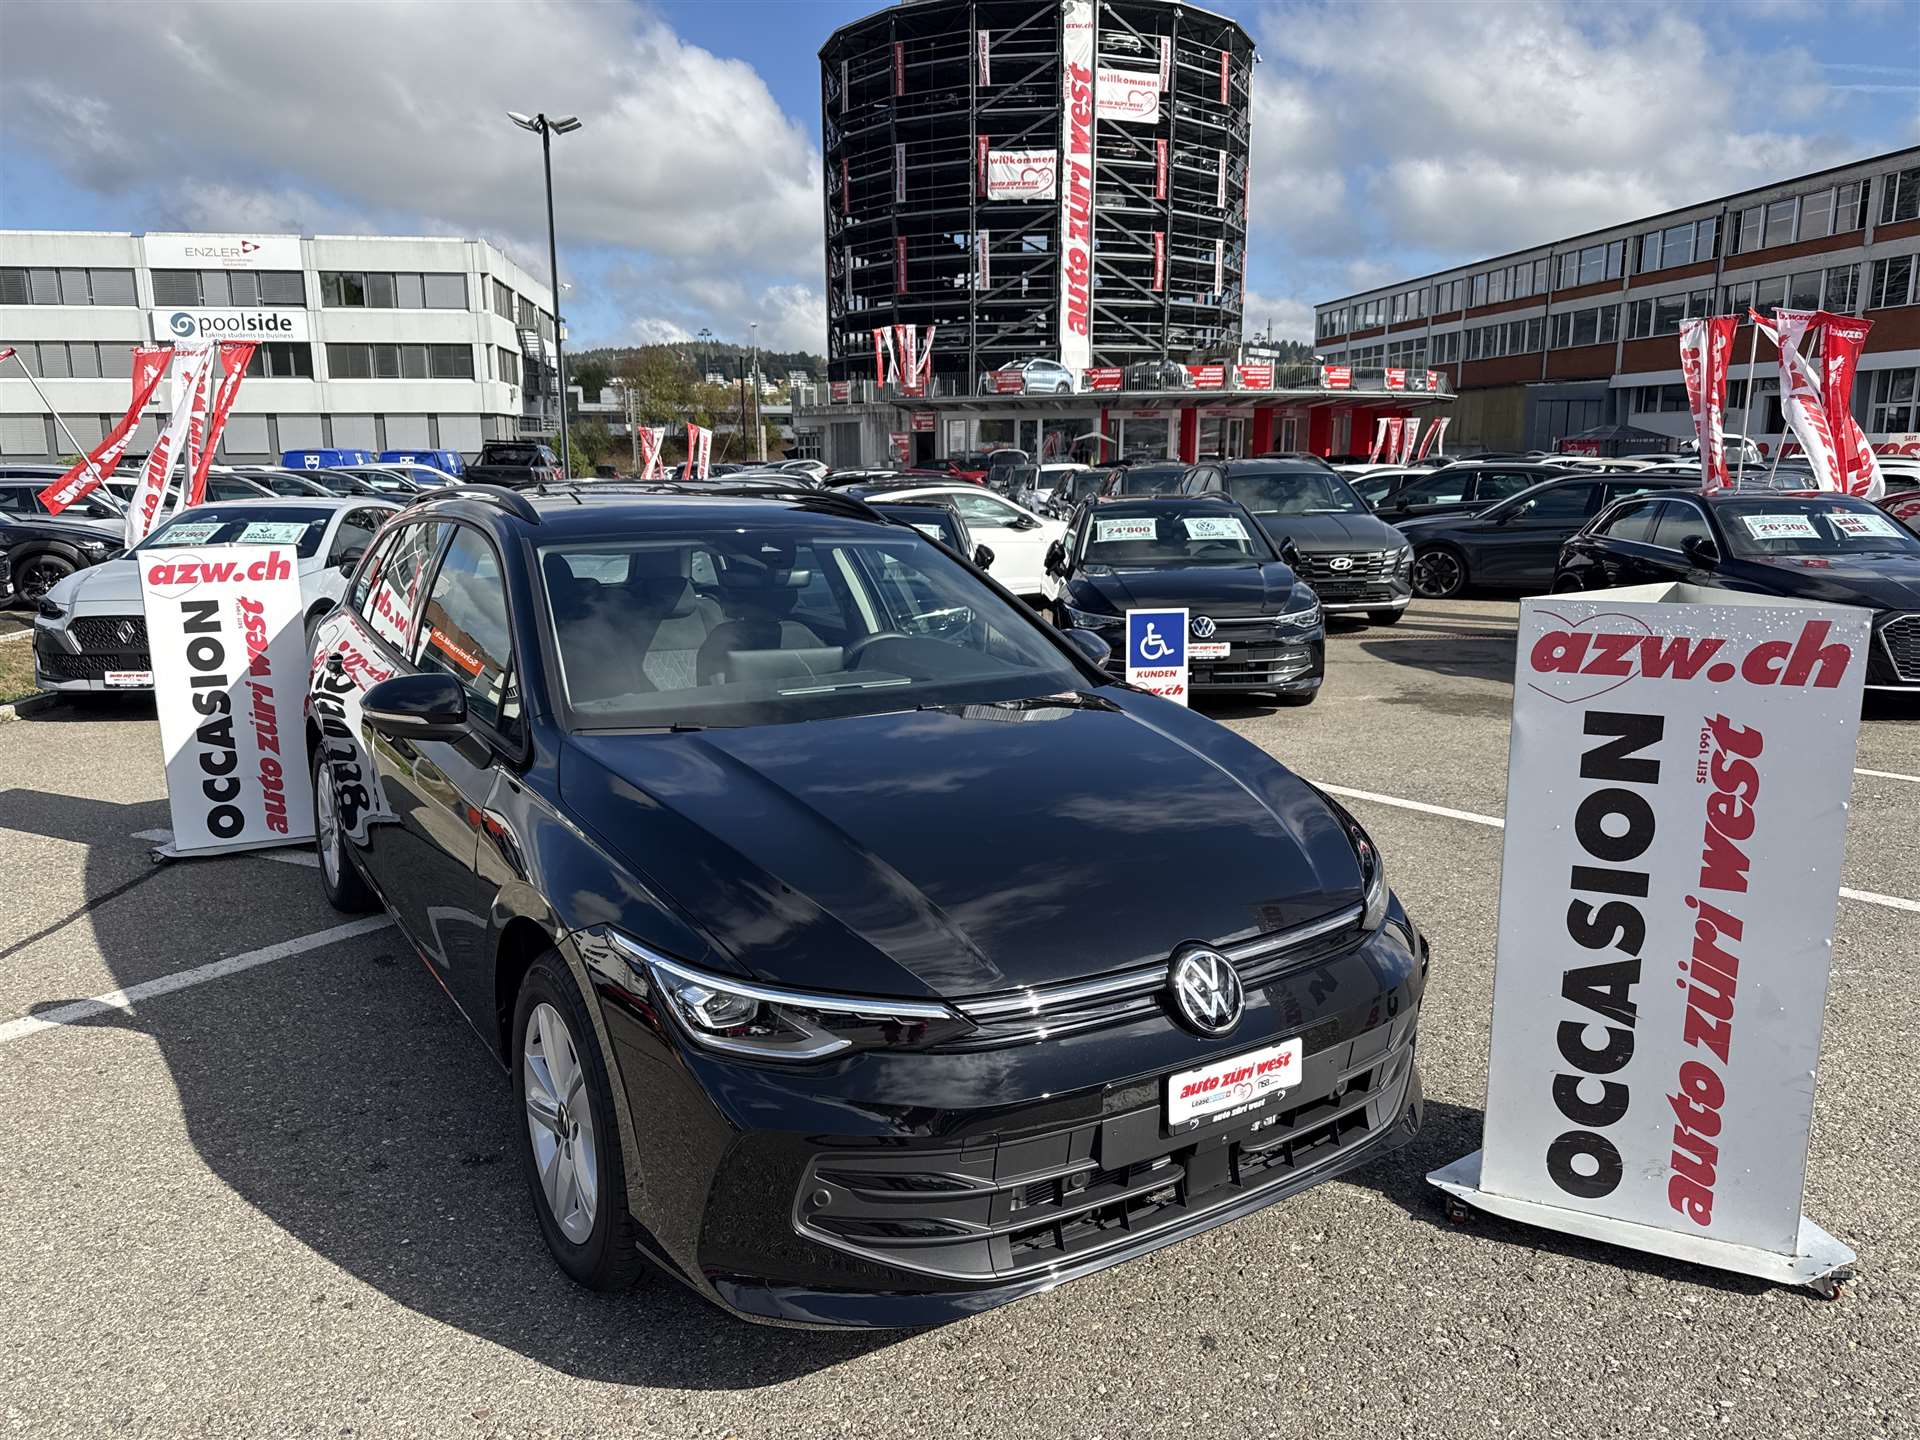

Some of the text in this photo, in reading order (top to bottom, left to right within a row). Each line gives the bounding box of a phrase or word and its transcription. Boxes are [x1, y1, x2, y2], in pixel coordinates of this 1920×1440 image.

[1099, 74, 1158, 87] willkommen
[990, 155, 1055, 165] willkommen
[1063, 61, 1093, 336] auto züri west
[185, 247, 241, 257] ENZLER
[198, 312, 292, 338] poolside
[205, 332, 226, 340] taking
[1106, 526, 1151, 534] 24'800
[1759, 523, 1810, 532] 26'300
[148, 551, 291, 586] azw.ch
[1529, 620, 1851, 689] azw.ch
[1136, 670, 1178, 679] KUNDEN
[180, 599, 245, 840] OCCASION
[236, 595, 290, 834] auto züri west
[1696, 727, 1712, 785] SEIT 1991
[1546, 710, 1665, 1199] OCCASION
[1667, 713, 1764, 1227] auto züri west
[1180, 1052, 1292, 1099] auto züri west
